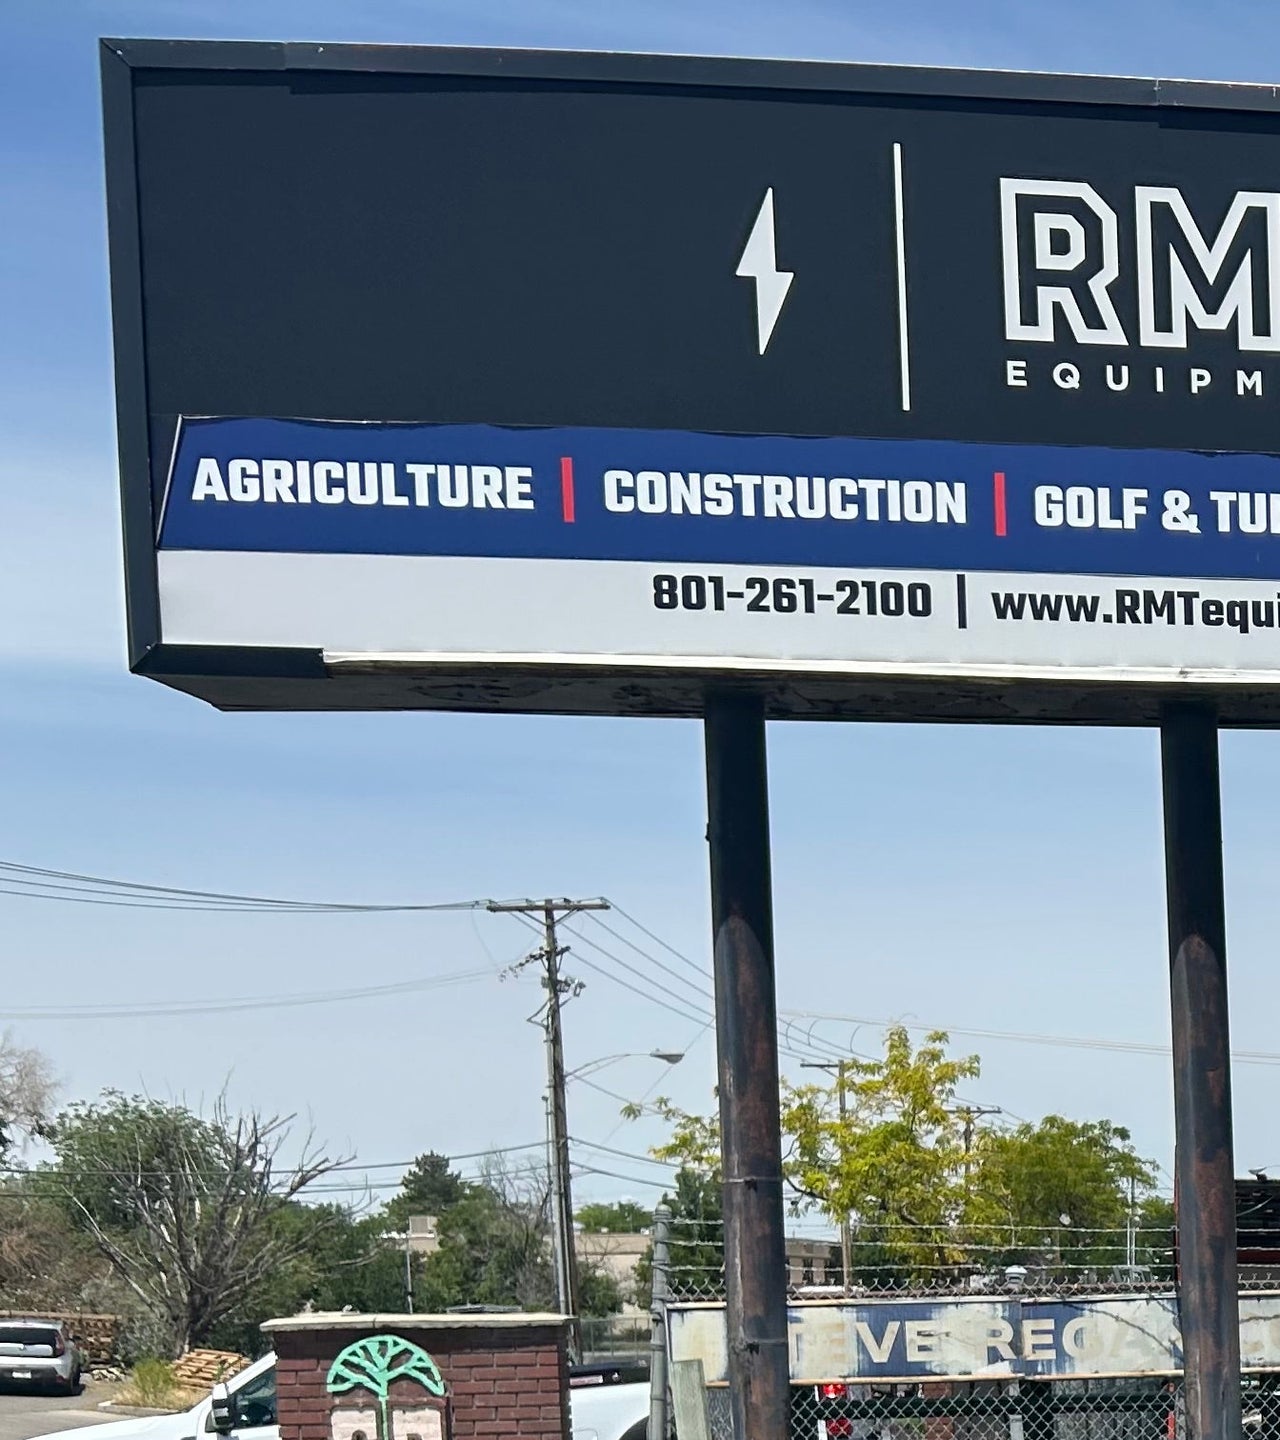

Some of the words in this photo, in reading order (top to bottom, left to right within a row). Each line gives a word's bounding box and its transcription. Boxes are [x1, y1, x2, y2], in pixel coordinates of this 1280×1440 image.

[192, 456, 535, 511] AGRICULTURE
[604, 469, 967, 524] CONSTRUCTION
[1033, 484, 1148, 530] GOLF
[1161, 490, 1199, 534] &
[653, 574, 932, 618] 801-261-2100
